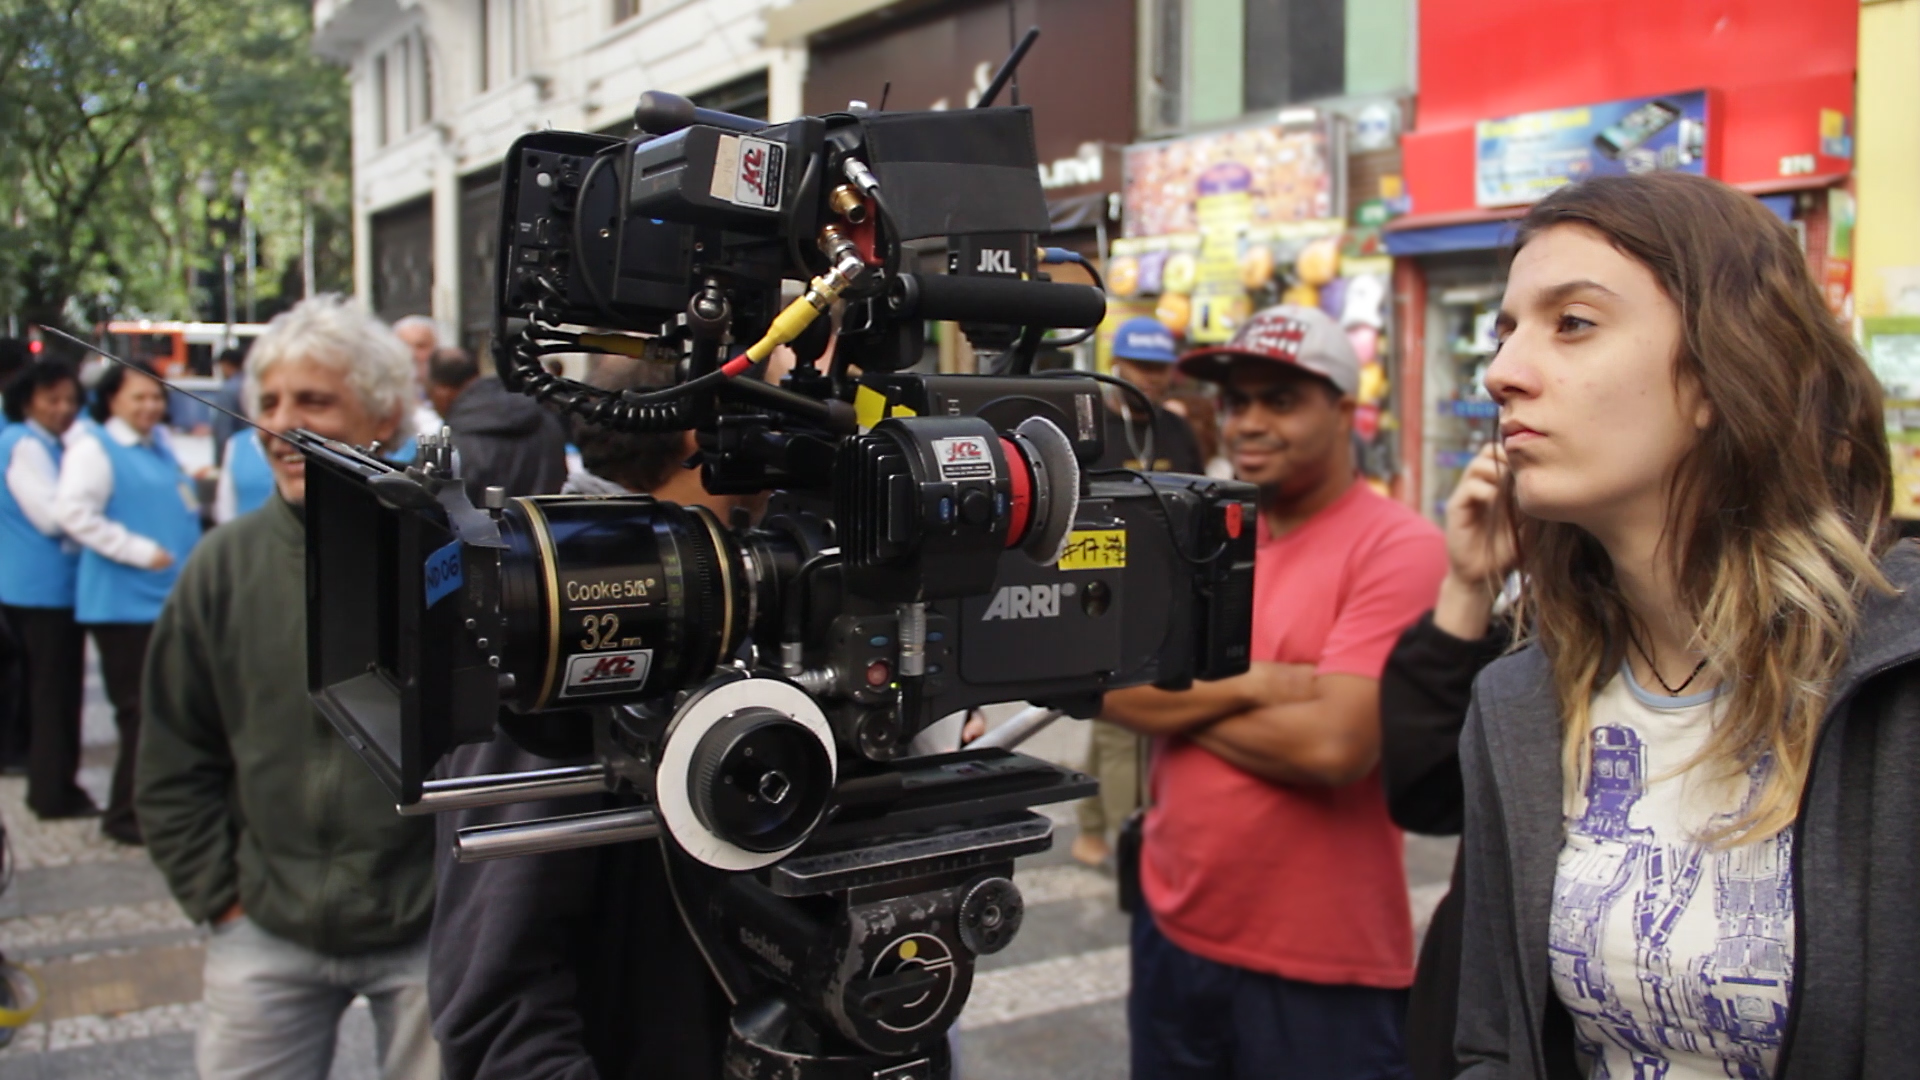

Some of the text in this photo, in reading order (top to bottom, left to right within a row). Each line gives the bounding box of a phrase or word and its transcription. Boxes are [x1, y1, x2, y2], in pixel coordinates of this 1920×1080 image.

[977, 248, 1018, 273] JKL
[566, 580, 622, 601] Cooke
[981, 583, 1060, 621] ARRI
[580, 613, 619, 651] 32
